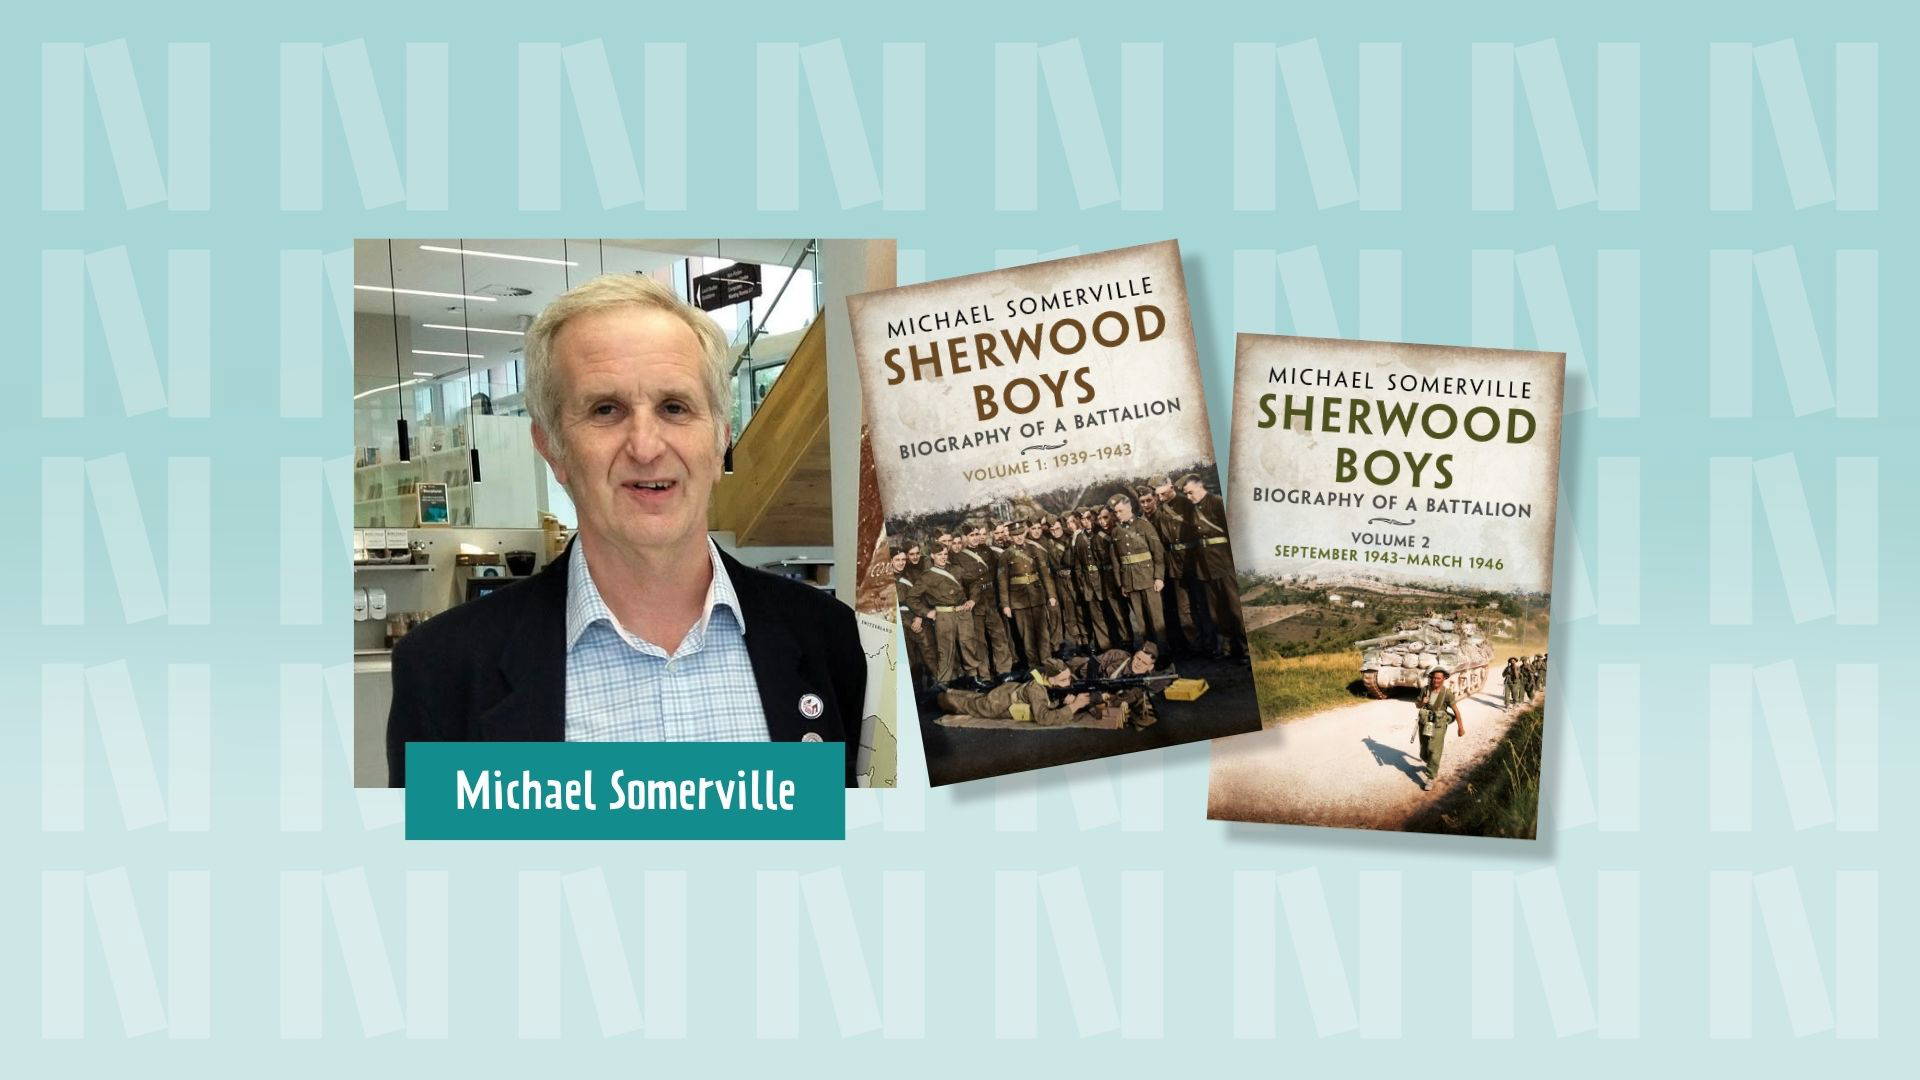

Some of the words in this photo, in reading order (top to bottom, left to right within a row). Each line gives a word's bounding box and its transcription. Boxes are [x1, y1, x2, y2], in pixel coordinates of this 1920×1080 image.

[887, 304, 995, 339] MICHAEL
[1006, 276, 1153, 318] SOMERVILLE
[883, 304, 1166, 386] SHERWOOD
[972, 366, 1096, 422] BOYS
[1268, 366, 1374, 390] MICHAEL
[1387, 373, 1532, 400] SOMERVILLE
[899, 426, 1012, 461] BIOGRAPHY
[1019, 420, 1045, 439] OF
[1054, 417, 1067, 434] A
[1073, 397, 1182, 430] BATTALION
[1257, 392, 1537, 445] SHERWOOD
[962, 460, 1030, 484] VOLUME
[1034, 458, 1048, 471] 1:
[1335, 447, 1454, 490] BOYS
[1252, 486, 1365, 508] BIOGRAPHY
[1372, 494, 1398, 510] OF
[1404, 496, 1418, 512] A
[1426, 497, 1532, 519] BATTALION
[1274, 544, 1358, 562] SEPTEMBER
[1469, 556, 1504, 571] 1946
[1351, 531, 1416, 548] VOLUME
[1421, 535, 1430, 549] 2
